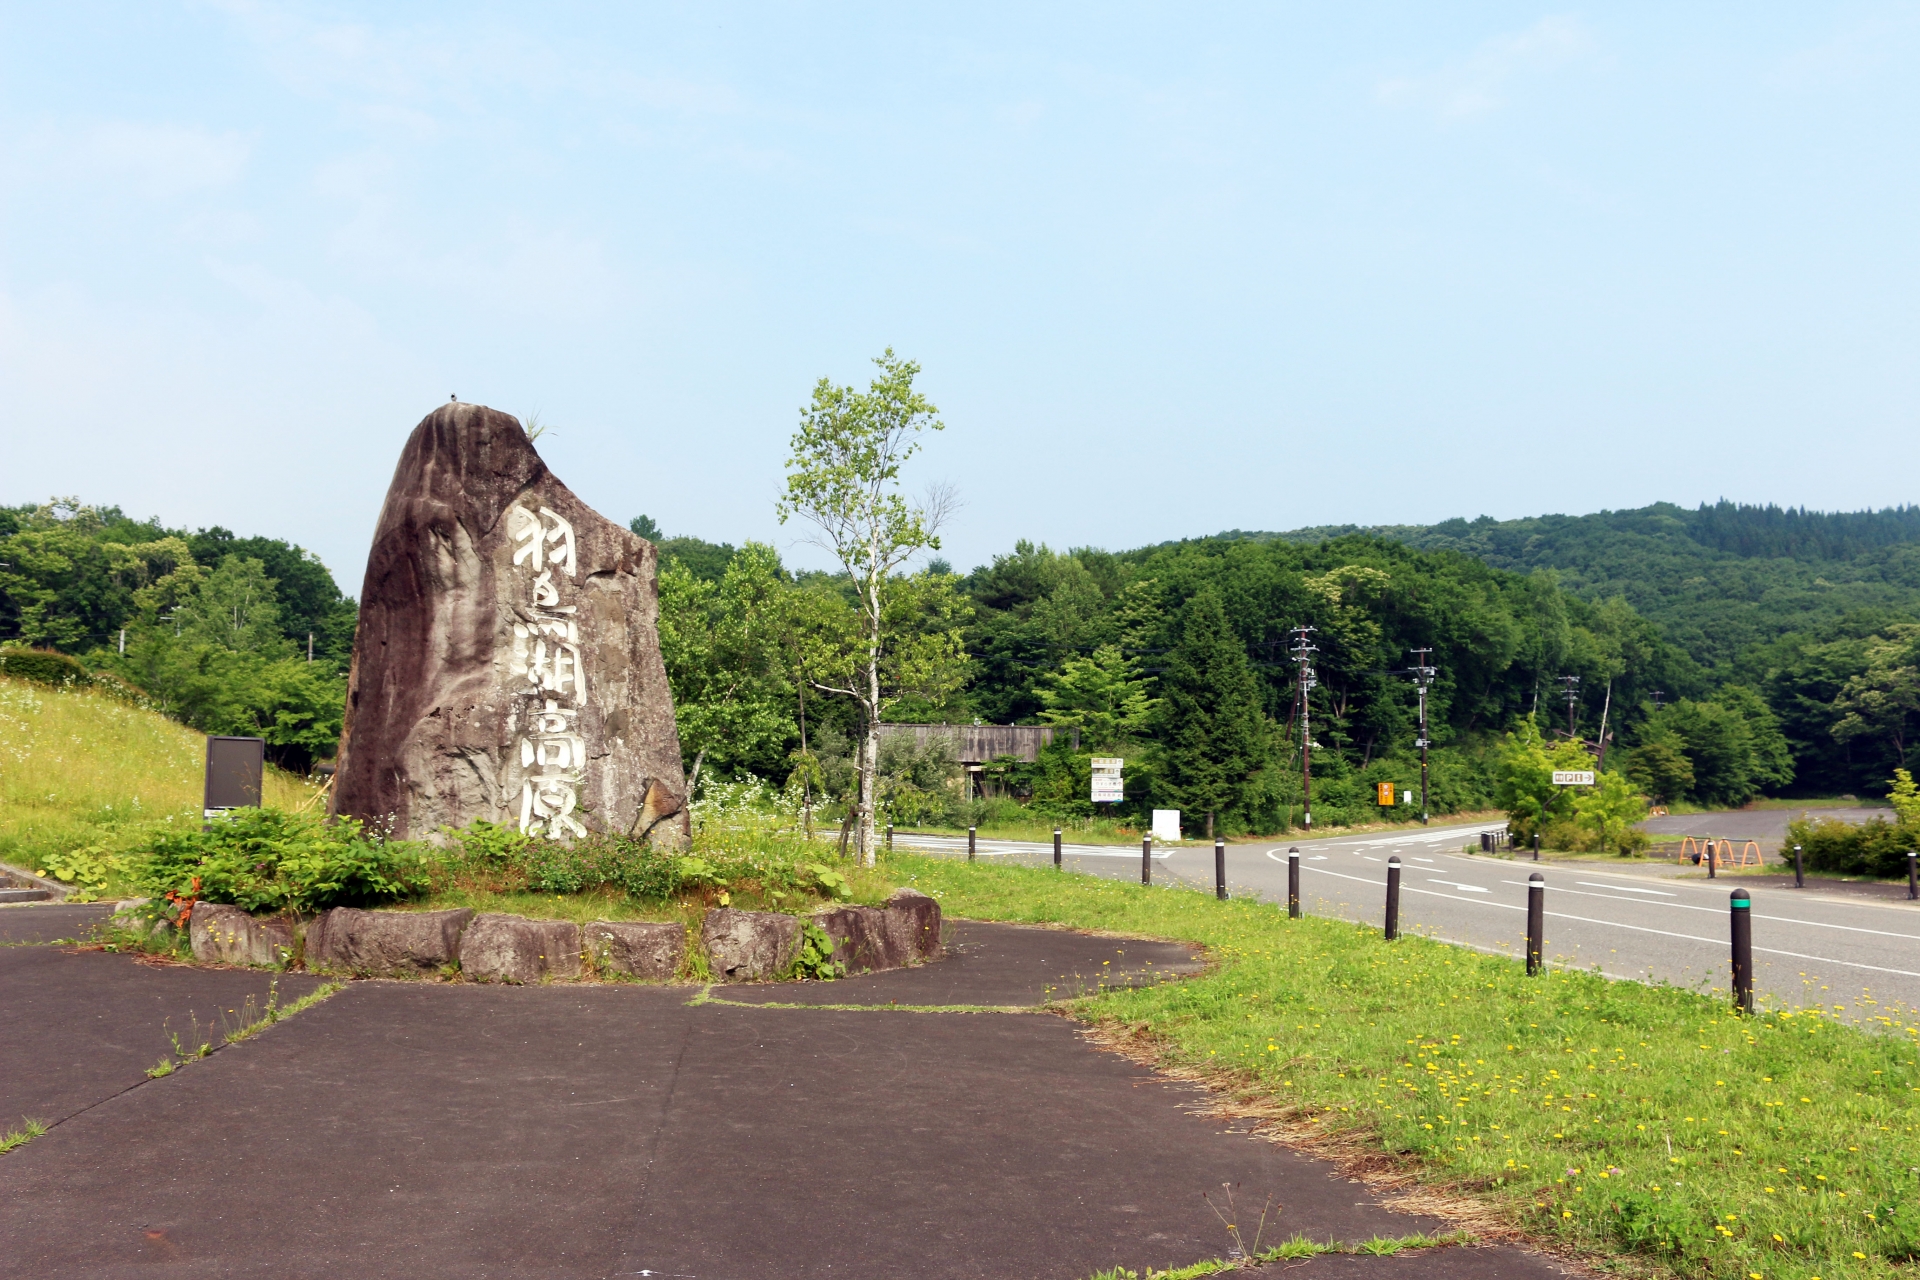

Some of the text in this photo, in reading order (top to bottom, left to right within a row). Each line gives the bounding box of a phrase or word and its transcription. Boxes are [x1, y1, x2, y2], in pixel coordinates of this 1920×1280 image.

[510, 505, 588, 839] 羽鳥湖高原
